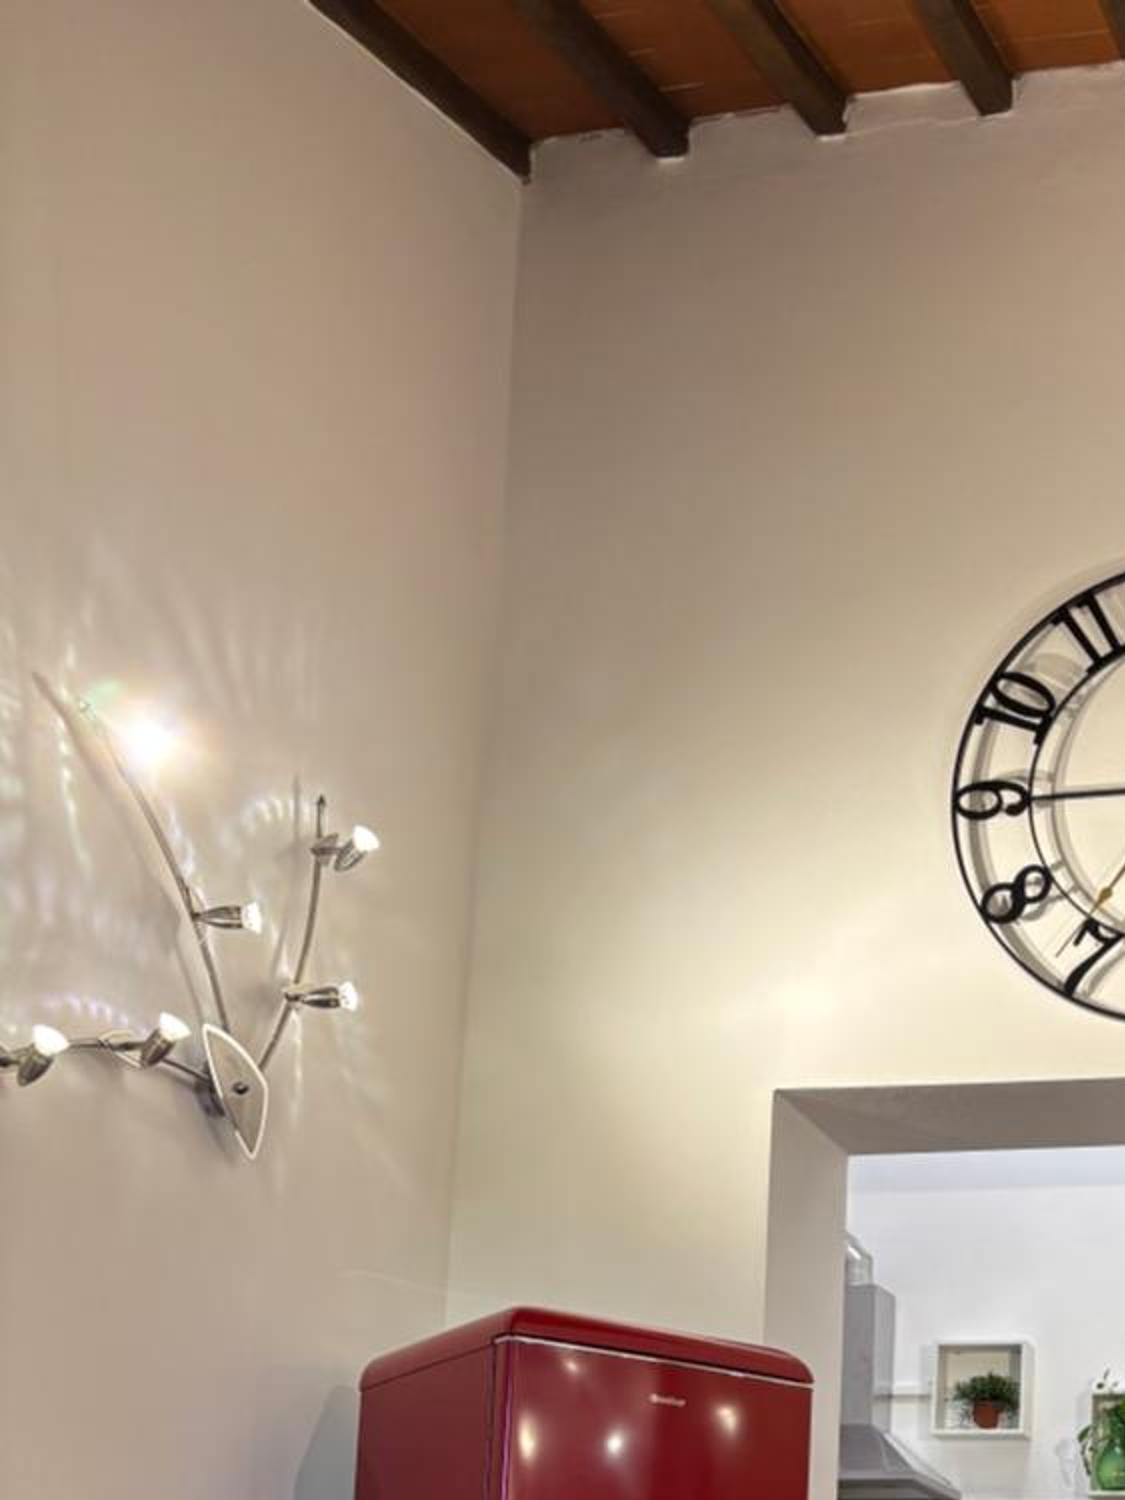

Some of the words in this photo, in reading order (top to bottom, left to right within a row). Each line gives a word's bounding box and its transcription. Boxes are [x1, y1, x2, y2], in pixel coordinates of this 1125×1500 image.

[975, 670, 1056, 744] 10
[955, 780, 1031, 821] 9
[981, 864, 1051, 924] 8
[1065, 920, 1122, 998] 7
